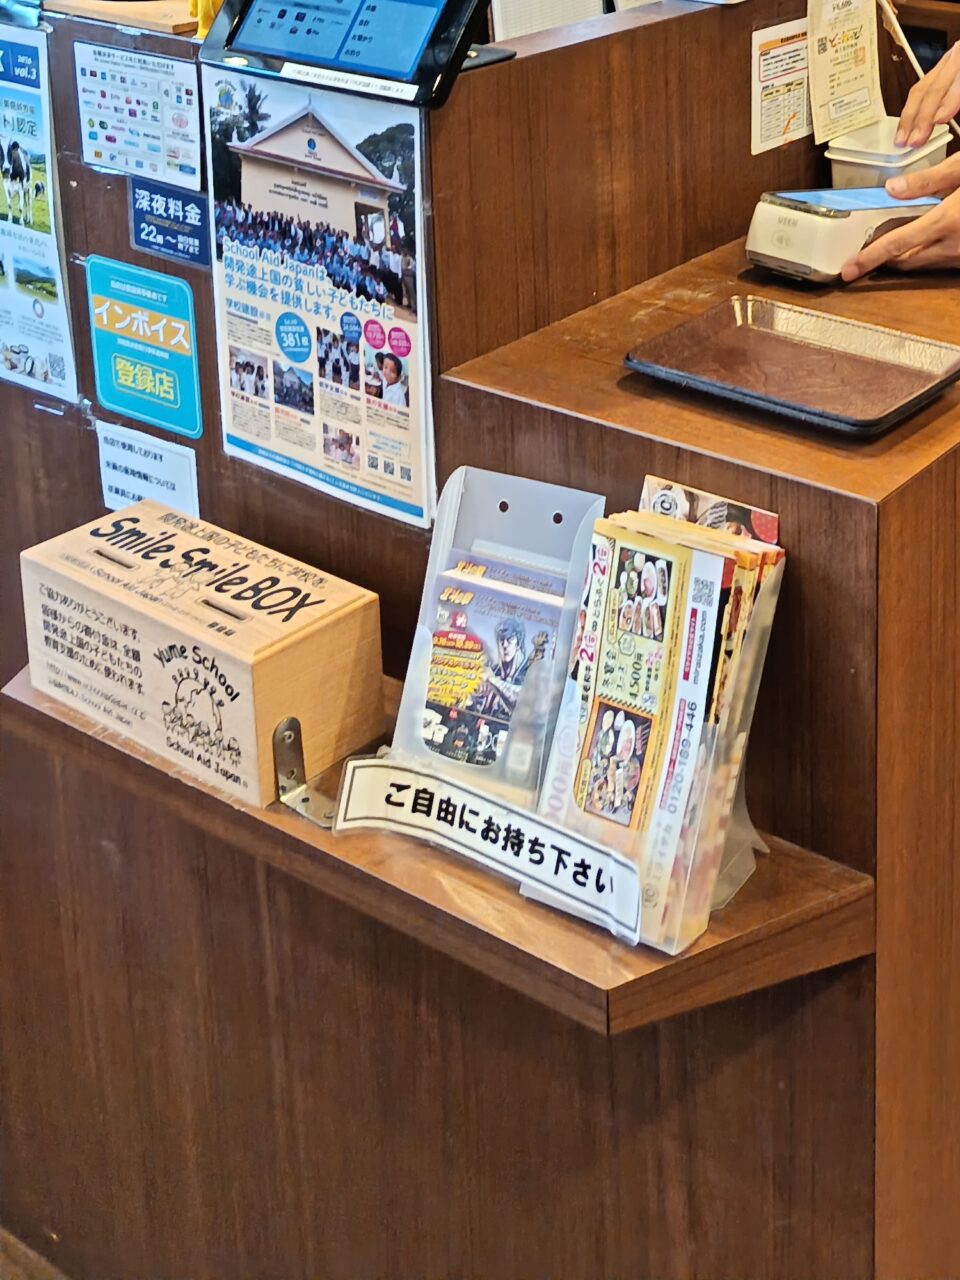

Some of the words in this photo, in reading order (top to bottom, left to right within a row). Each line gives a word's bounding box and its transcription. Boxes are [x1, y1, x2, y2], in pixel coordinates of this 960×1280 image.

[14, 66, 37, 80] vol.3
[135, 188, 202, 226] 深夜料金
[223, 239, 260, 261] School
[262, 252, 280, 267] Aid
[223, 256, 394, 320] 開発途上国の貧しい子どもたちに
[224, 274, 337, 320] 学ぶ機会を提供します。
[94, 301, 190, 350] インボイス
[115, 358, 175, 400] 登録店
[90, 517, 175, 560] Smile
[692, 610, 709, 686] miraizaka.com
[154, 643, 188, 668] Yume
[192, 646, 240, 703] School
[165, 737, 195, 762] School
[197, 753, 212, 772] Aid
[214, 761, 242, 789] Japan
[384, 782, 614, 895] ご自由にお持ち下さい
